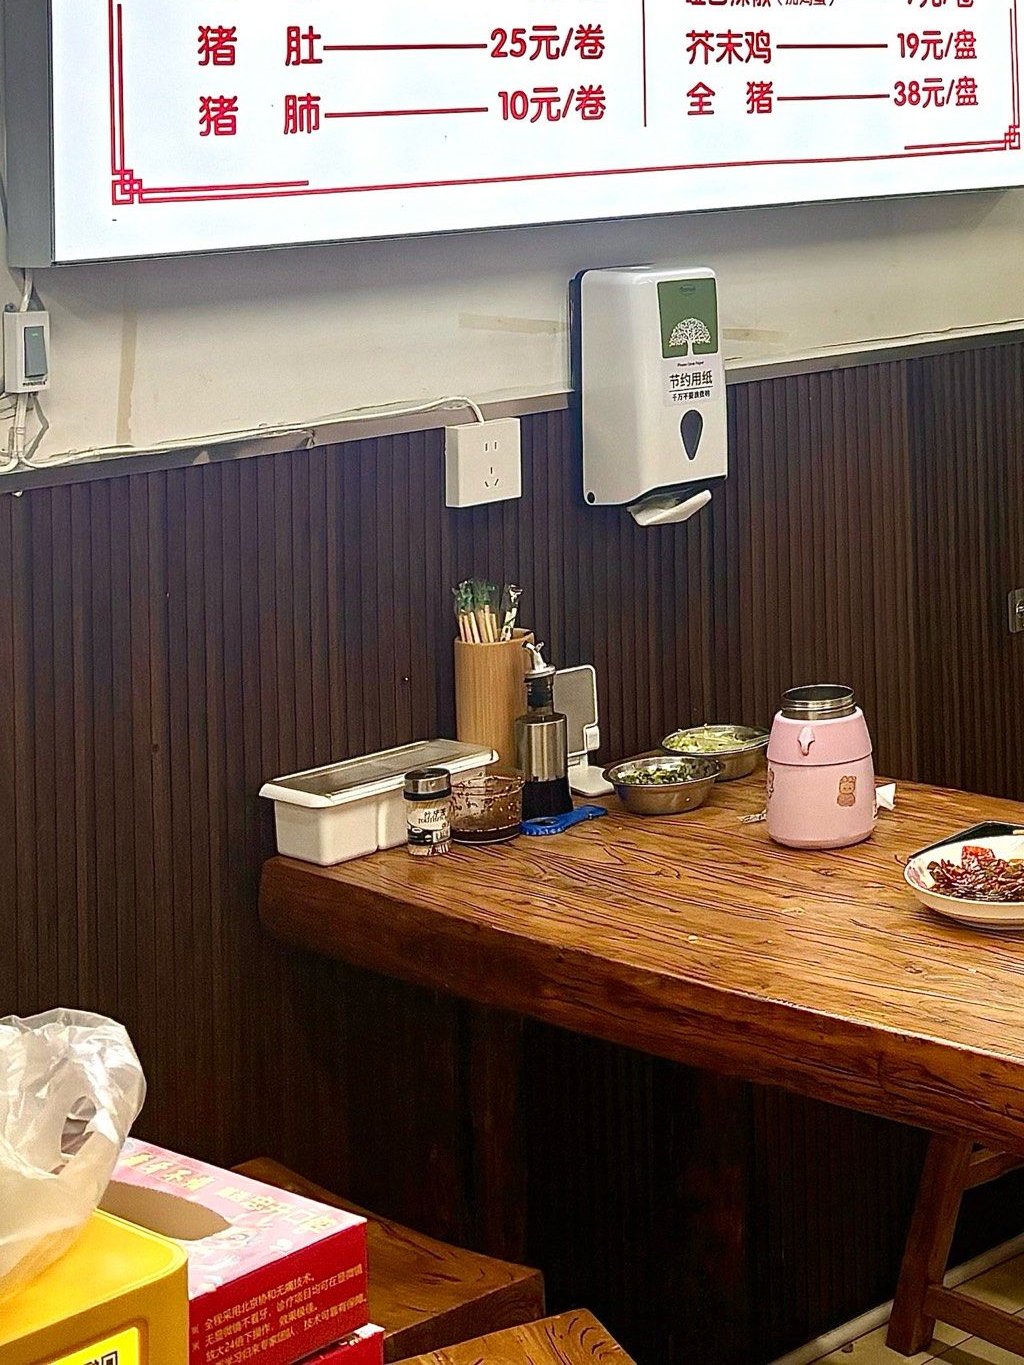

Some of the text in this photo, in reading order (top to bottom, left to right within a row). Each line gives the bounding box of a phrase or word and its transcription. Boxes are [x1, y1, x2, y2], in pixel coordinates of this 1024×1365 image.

[490, 24, 605, 61] 25元/卷
[686, 29, 977, 65] 芥末鸡 19元/盘
[498, 85, 606, 123] 10元/卷
[893, 76, 978, 108] 38元/盘
[669, 370, 713, 389] 节约用纸
